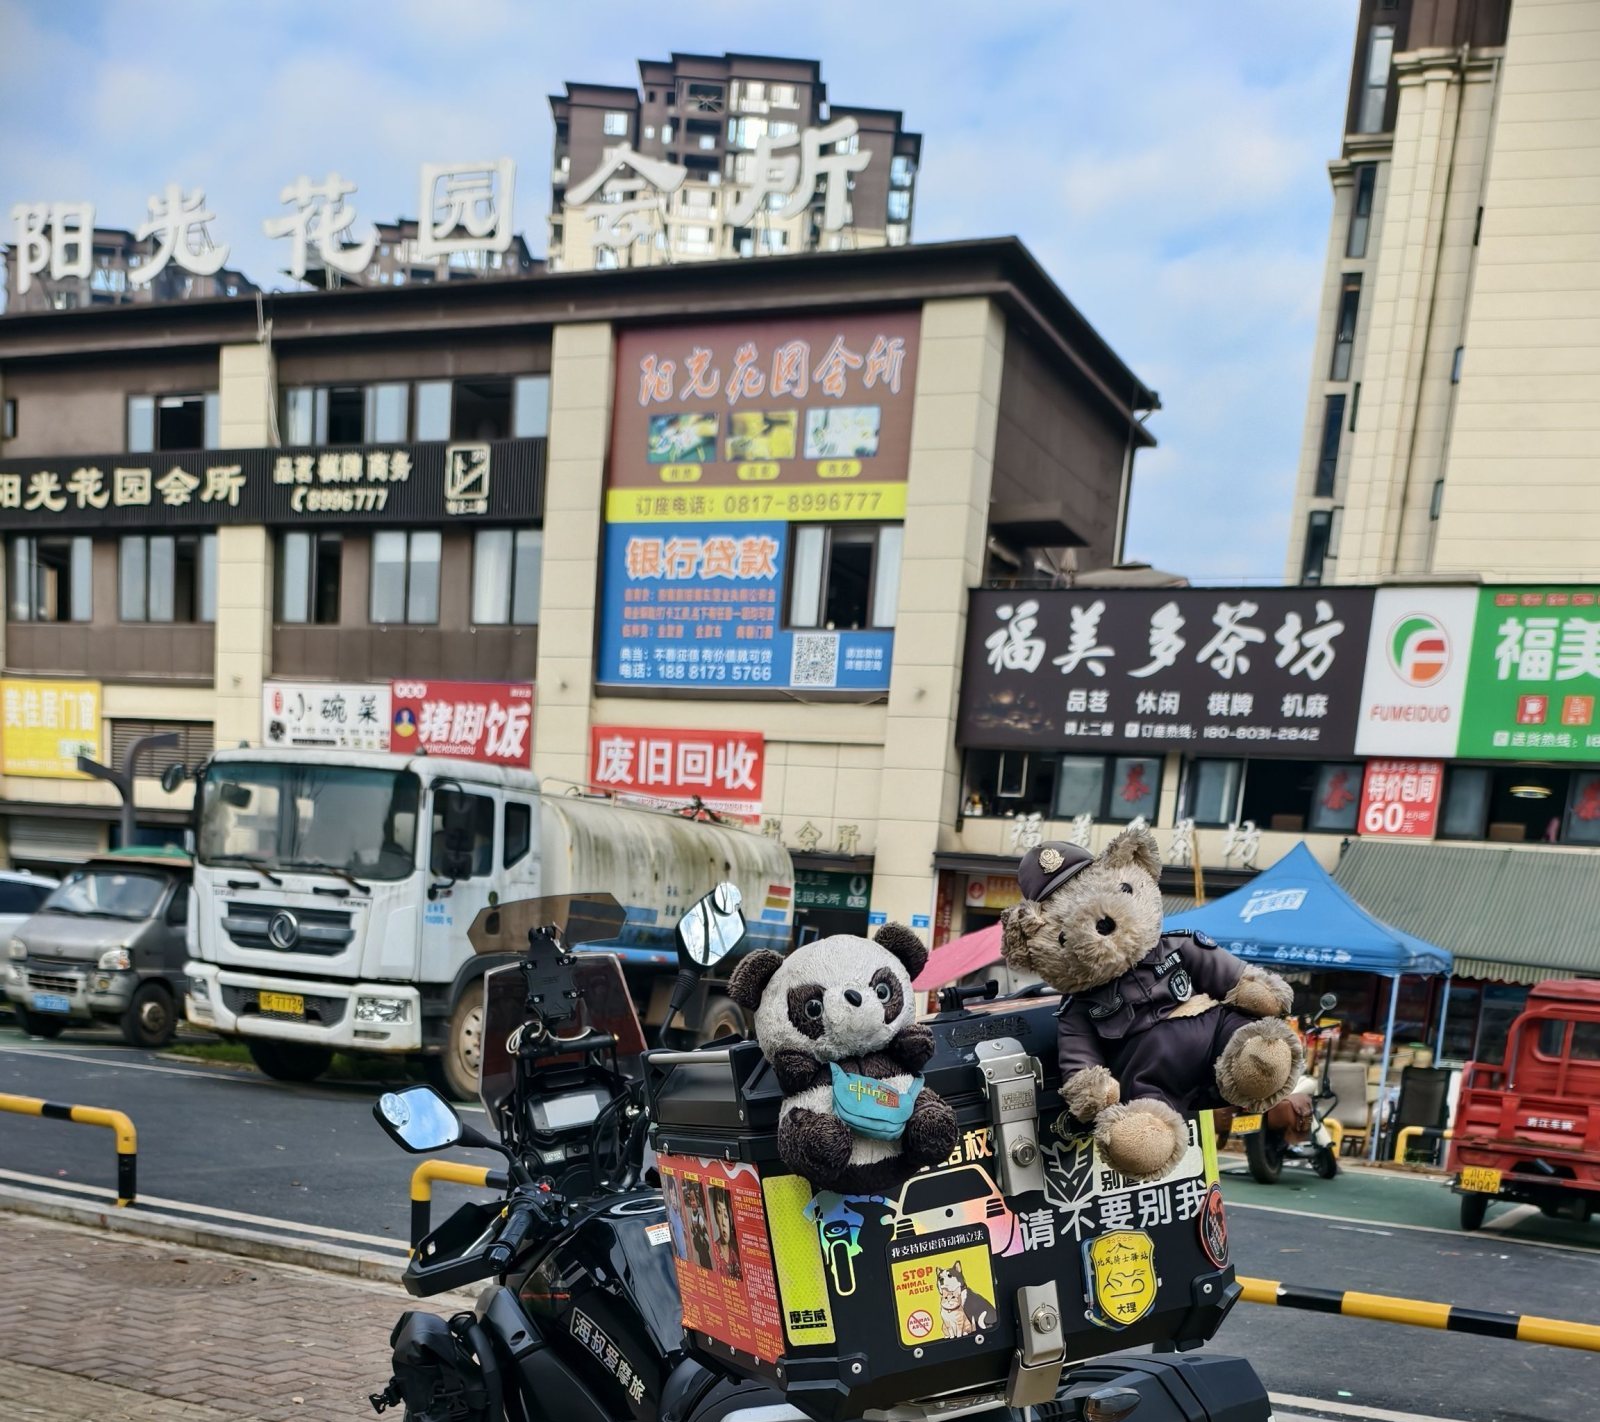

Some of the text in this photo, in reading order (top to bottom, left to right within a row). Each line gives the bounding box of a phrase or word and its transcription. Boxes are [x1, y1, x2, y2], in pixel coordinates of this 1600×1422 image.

[14, 117, 871, 294] 阳光花园会所
[636, 334, 906, 407] 阳光花园会所
[724, 492, 883, 514] 0817-8996777
[625, 536, 779, 581] 银行贷款
[985, 599, 1344, 679] 福美多茶坊
[658, 664, 685, 679] 188
[688, 664, 726, 680] 8173
[288, 692, 378, 724] 小碗菜
[1066, 690, 1329, 717] 品茗 休闲 棋牌 机麻
[1371, 704, 1450, 723] FUMEIDUO
[418, 699, 531, 758] 猪脚饭
[596, 737, 759, 791] 废旧回收
[1365, 802, 1405, 832] 60
[1019, 1178, 1207, 1251] 请不要别我
[891, 1230, 984, 1258] 我支持反虐待动物立法
[896, 1279, 927, 1291] ANIMAL
[902, 1266, 933, 1282] STOP
[908, 1285, 934, 1296] ABUSE
[1116, 1301, 1137, 1315] 大理
